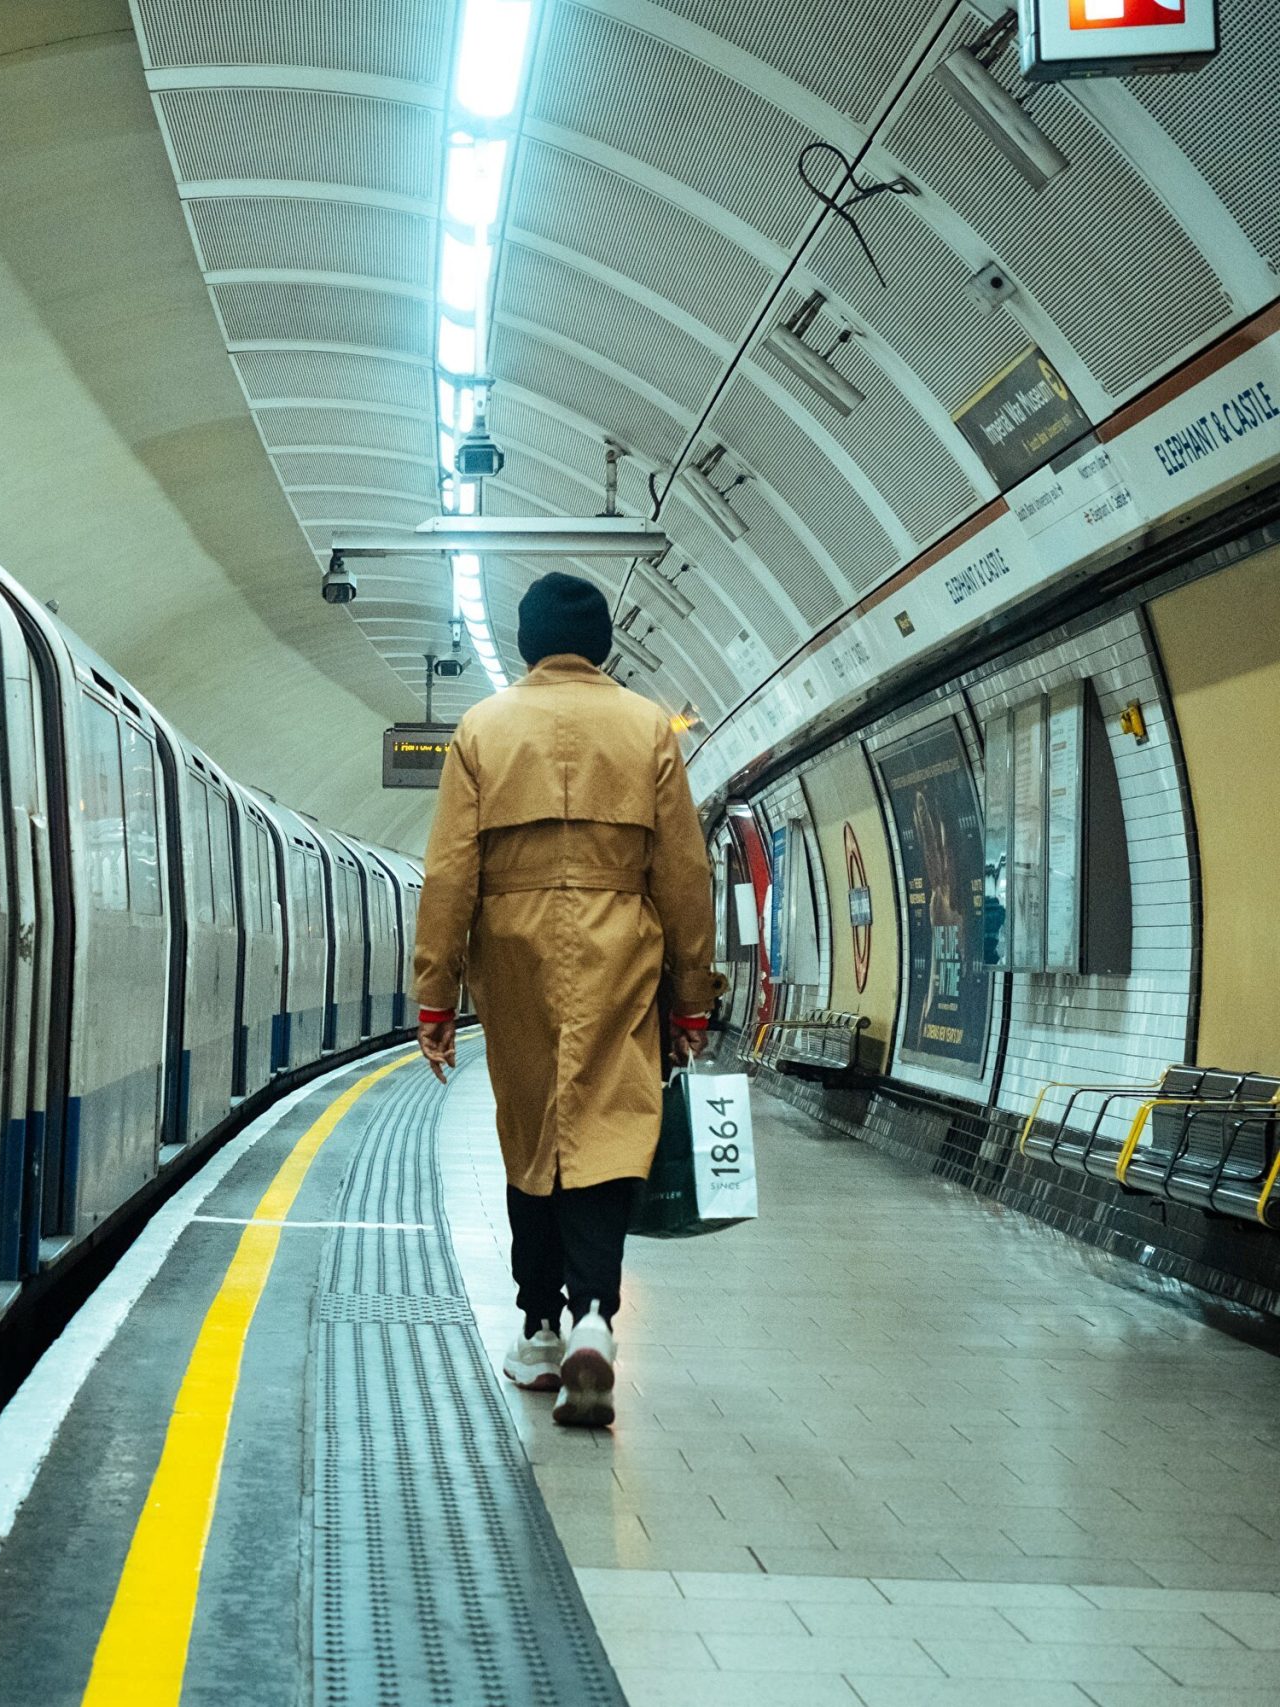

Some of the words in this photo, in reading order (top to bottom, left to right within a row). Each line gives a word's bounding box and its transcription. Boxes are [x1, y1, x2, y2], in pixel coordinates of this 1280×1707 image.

[980, 407, 1016, 446] Imperial
[1001, 400, 1028, 427] War
[1015, 379, 1056, 416] Museum
[1154, 416, 1219, 476] ELEPHANT
[1210, 411, 1233, 444] &
[1222, 381, 1280, 436] CASTLE
[973, 563, 987, 587] &
[979, 547, 1010, 583] CASTLE
[945, 566, 982, 604] ELEPHANT
[706, 1097, 740, 1177] 1864
[710, 1182, 740, 1190] SINCE
